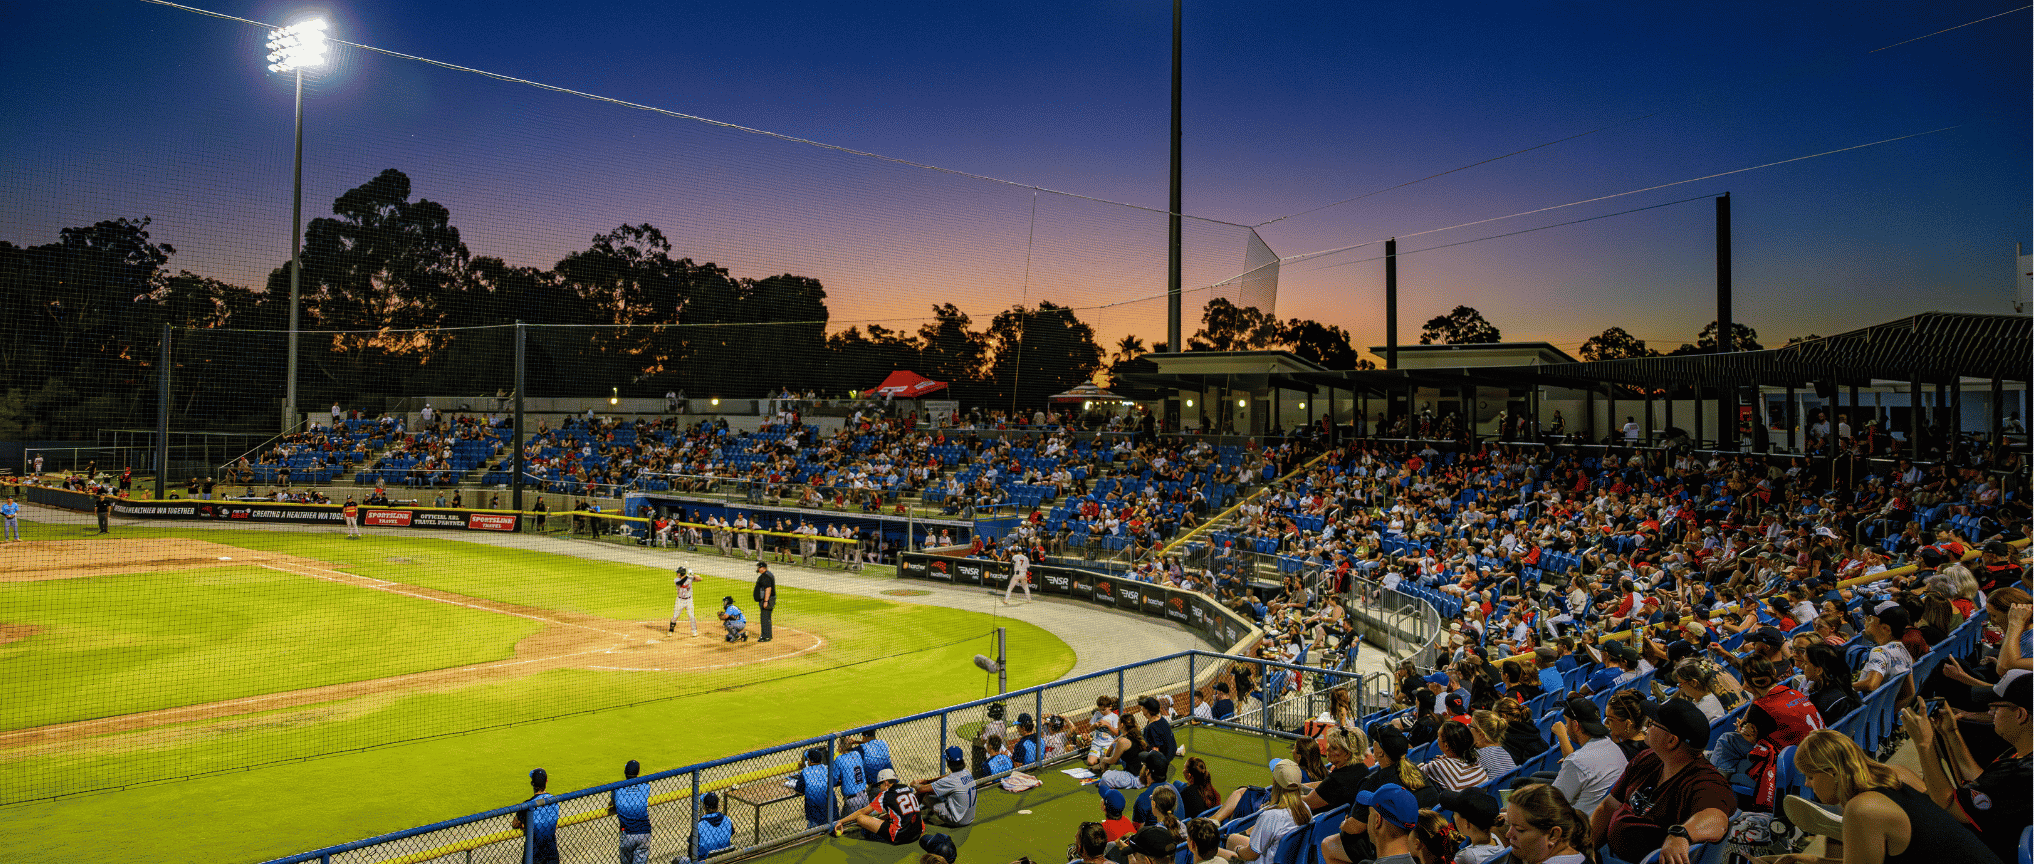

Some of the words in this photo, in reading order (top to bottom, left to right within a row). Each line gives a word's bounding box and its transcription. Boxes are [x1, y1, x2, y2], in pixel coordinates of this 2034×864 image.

[168, 507, 195, 515] TOGETHER
[252, 510, 280, 518] CREATING
[287, 511, 317, 519] HEALTHIER
[318, 512, 329, 520] WA
[1051, 576, 1069, 585] NSR
[967, 786, 978, 809] 17
[896, 793, 921, 815] 20
